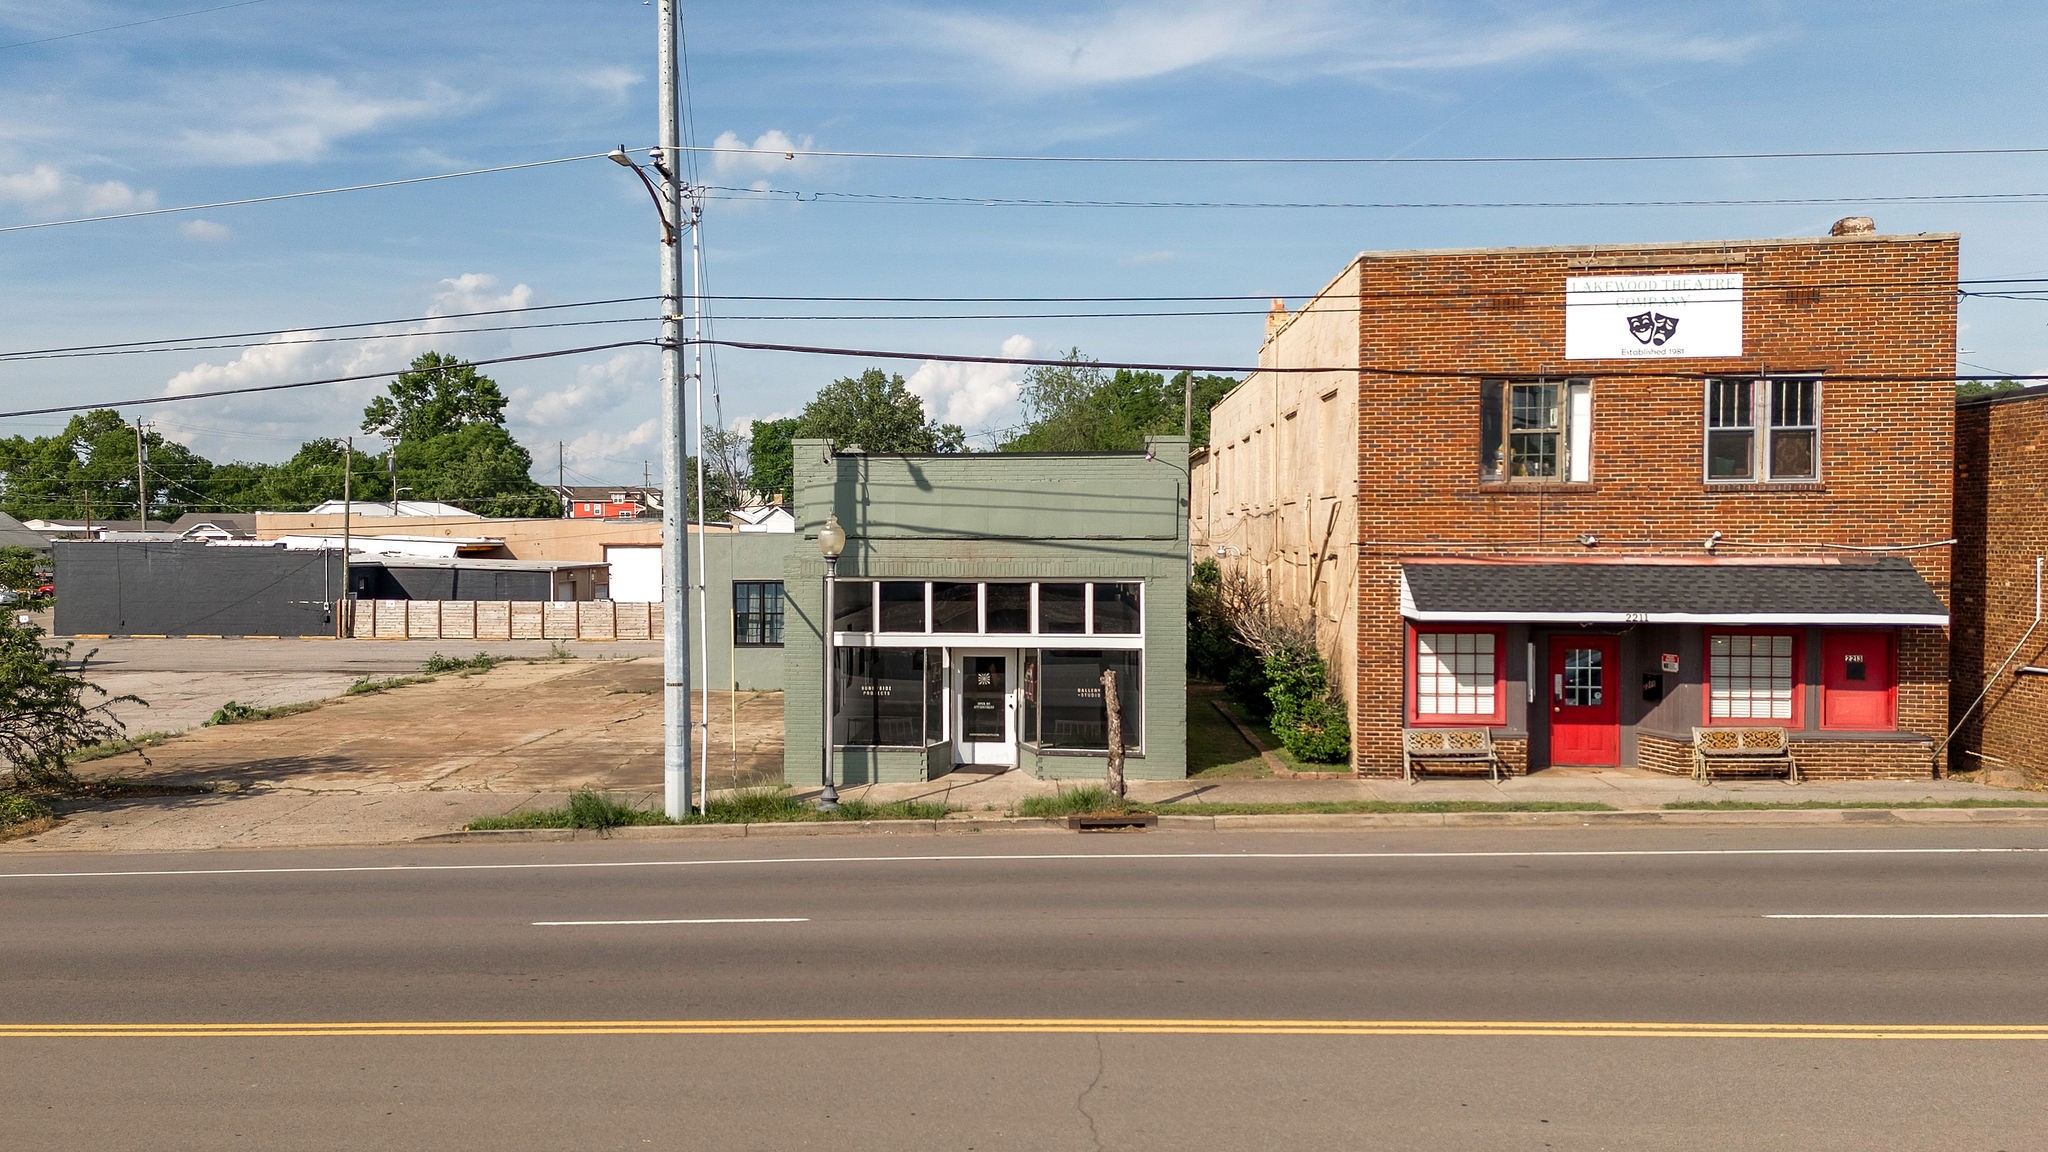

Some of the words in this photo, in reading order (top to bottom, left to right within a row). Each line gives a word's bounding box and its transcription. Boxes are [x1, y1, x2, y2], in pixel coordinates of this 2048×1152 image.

[1572, 280, 1658, 292] LAKEWOOD
[1662, 278, 1736, 291] THEATRE
[1616, 294, 1690, 308] COMPANY
[1621, 348, 1667, 356] Established
[1626, 613, 1649, 623] 2211
